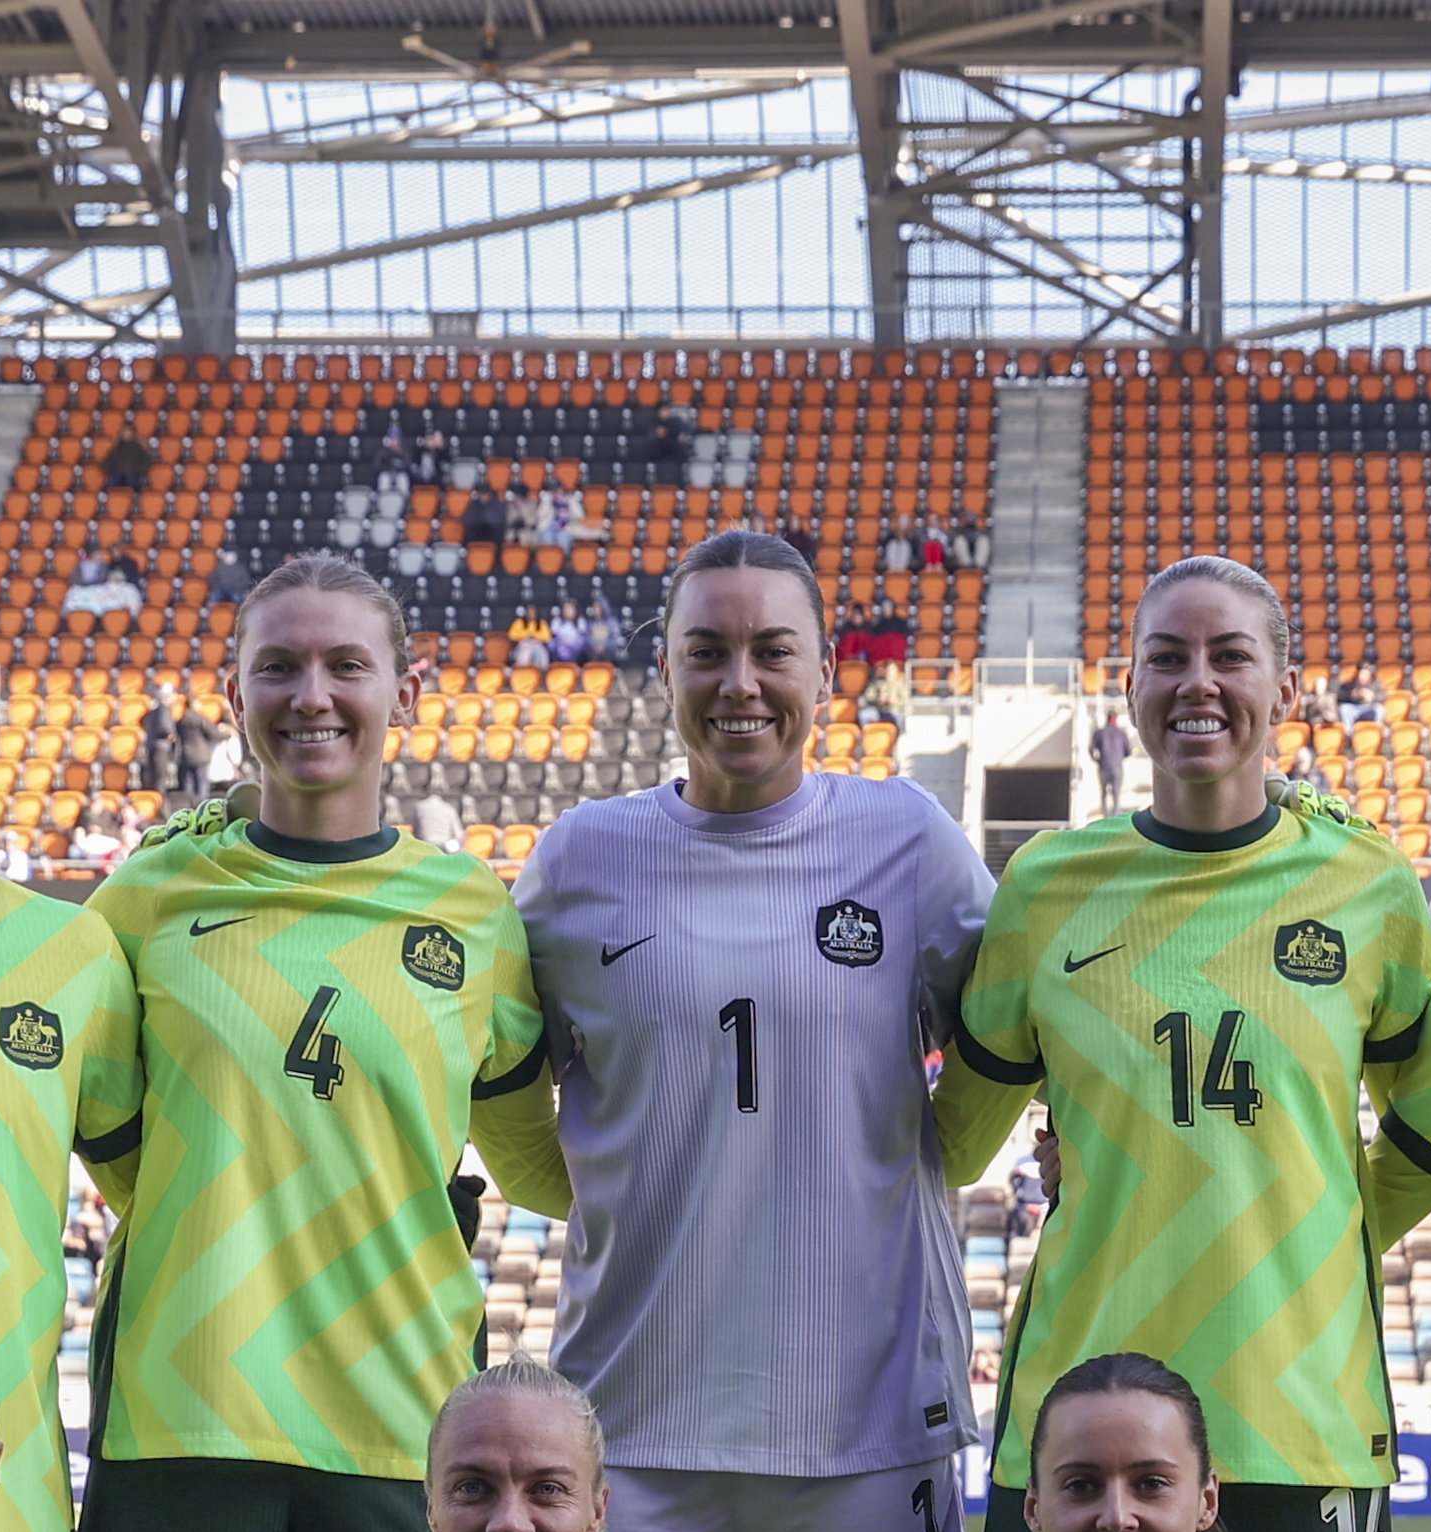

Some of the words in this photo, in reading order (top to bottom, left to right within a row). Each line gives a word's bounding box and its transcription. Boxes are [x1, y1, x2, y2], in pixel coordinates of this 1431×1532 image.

[829, 940, 873, 950] AUSTRALIA
[413, 959, 457, 978] AUSTRALIA
[1288, 960, 1335, 970] AUSTRALIA
[11, 1042, 54, 1054] AUSTRALIA
[283, 985, 344, 1100] 4
[719, 998, 758, 1113] 1
[1154, 1010, 1263, 1127] 14
